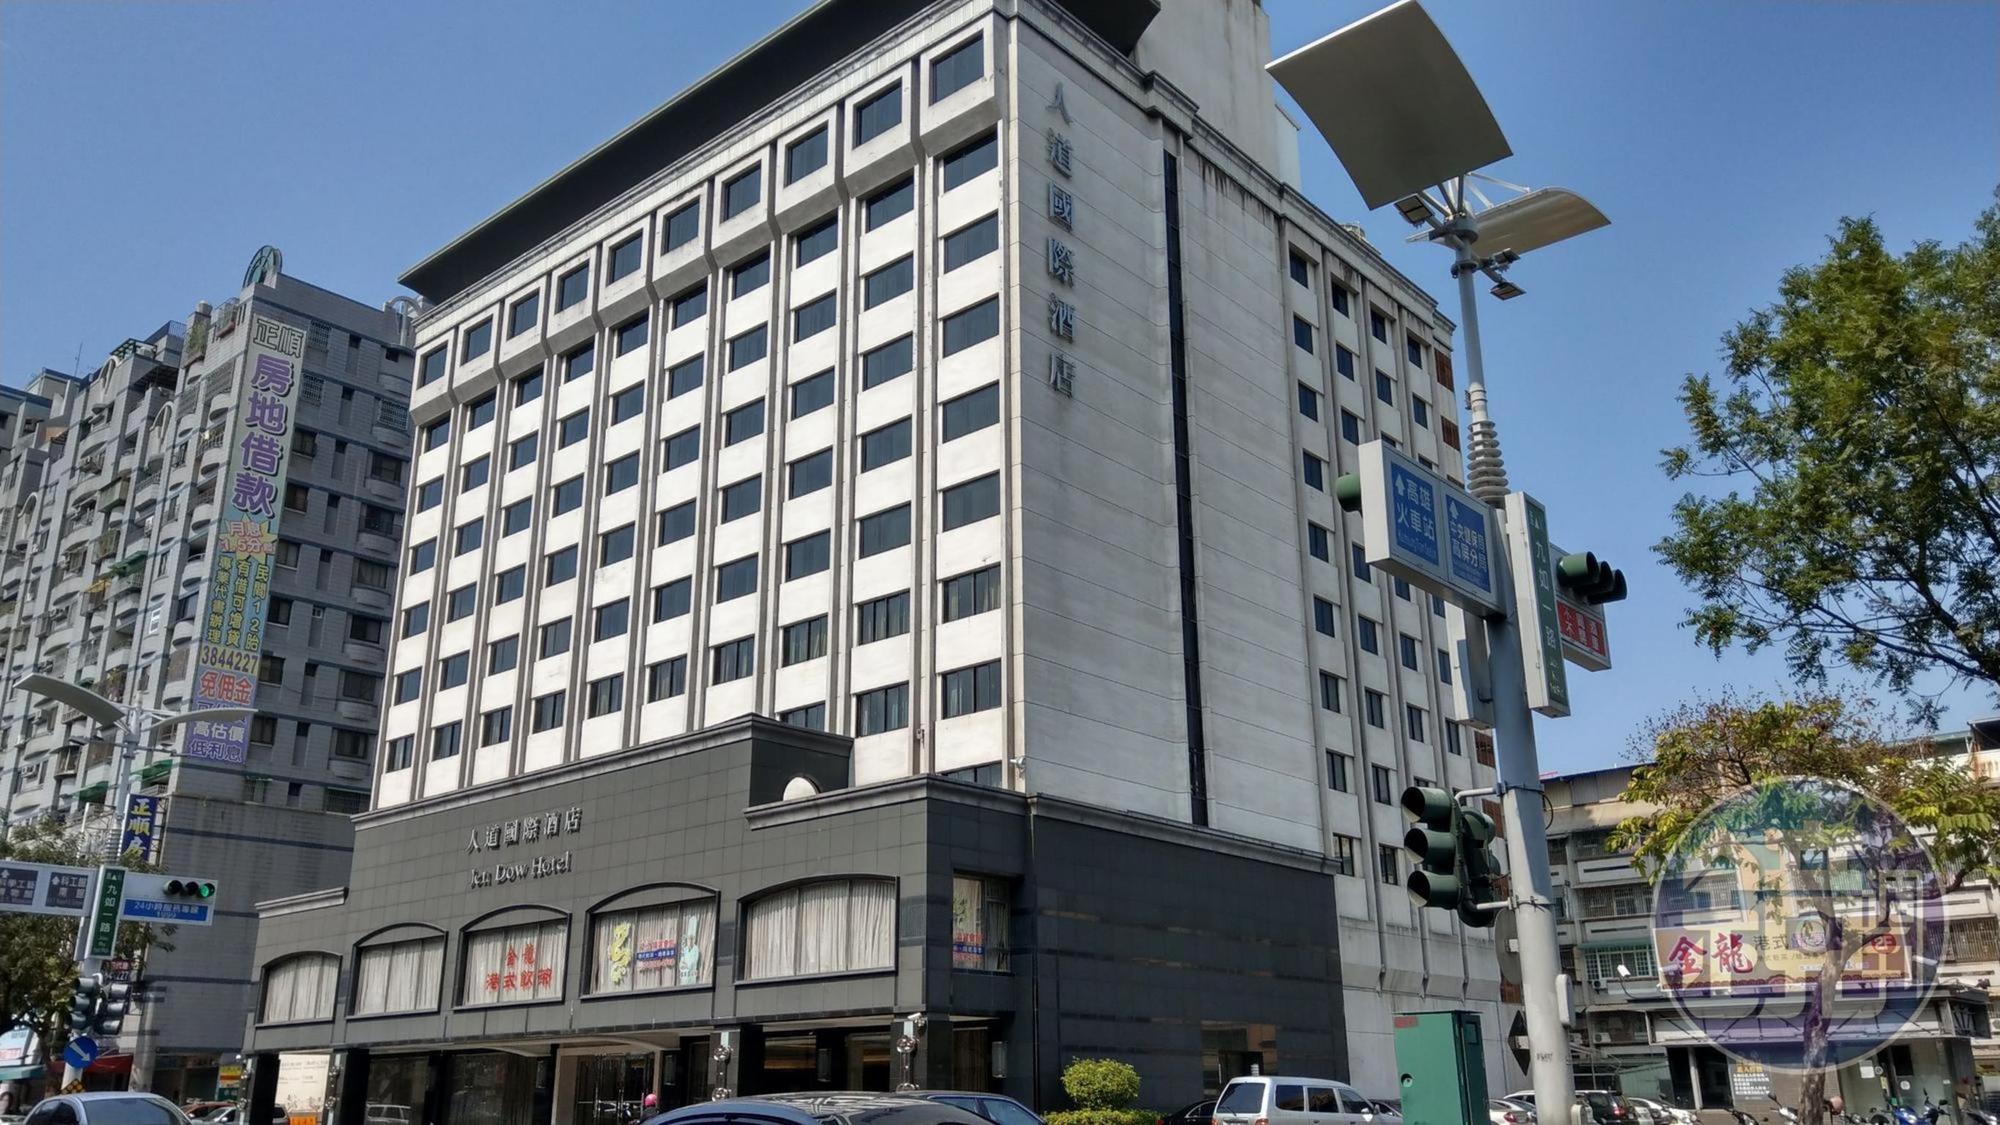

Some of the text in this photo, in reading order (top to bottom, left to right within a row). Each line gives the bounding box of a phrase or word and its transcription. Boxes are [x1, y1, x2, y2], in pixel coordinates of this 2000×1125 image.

[1047, 82, 1076, 398] 人道國際酒店
[253, 319, 303, 358] 正順
[233, 353, 294, 518] 房地借款
[1397, 502, 1435, 541] 火車站
[1535, 541, 1556, 650] 九如一路
[201, 645, 259, 674] 3844227
[199, 670, 253, 705] 免佣金
[189, 738, 242, 763] 低利息
[465, 806, 583, 854] 人道國際酒店
[471, 850, 572, 889] Jen Dow Hotel
[100, 884, 118, 933] 九如一路
[1667, 932, 1753, 976] 金龍
[486, 968, 552, 992] 港式飲茶
